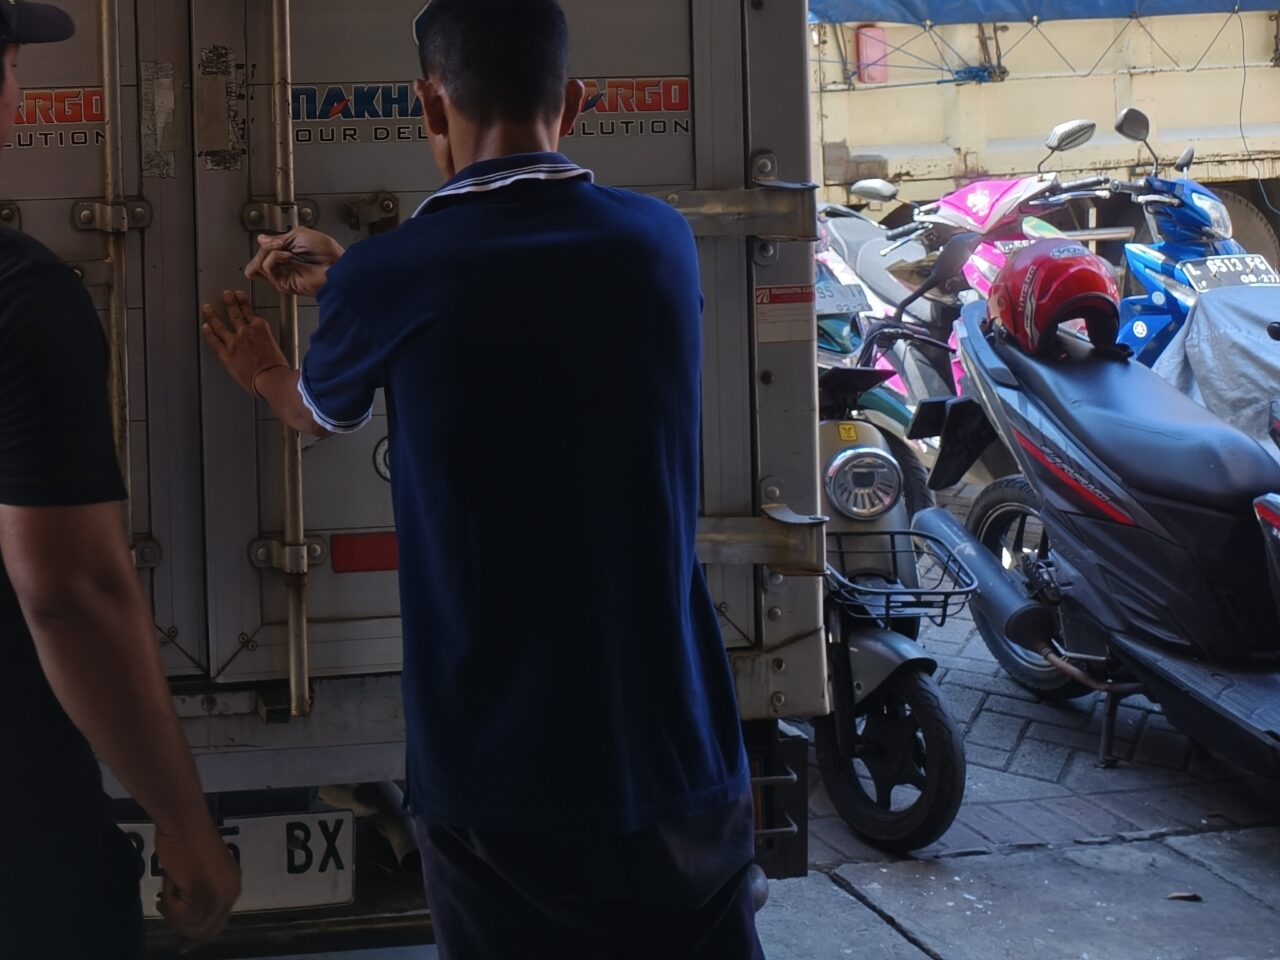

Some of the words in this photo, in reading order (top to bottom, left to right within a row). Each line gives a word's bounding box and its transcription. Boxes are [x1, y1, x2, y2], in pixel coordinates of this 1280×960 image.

[578, 77, 691, 115] ARGO
[293, 126, 360, 144] OUR
[373, 124, 429, 142] DEL
[567, 118, 690, 137] LUTION
[1185, 262, 1202, 276] L
[285, 818, 345, 875] BX
